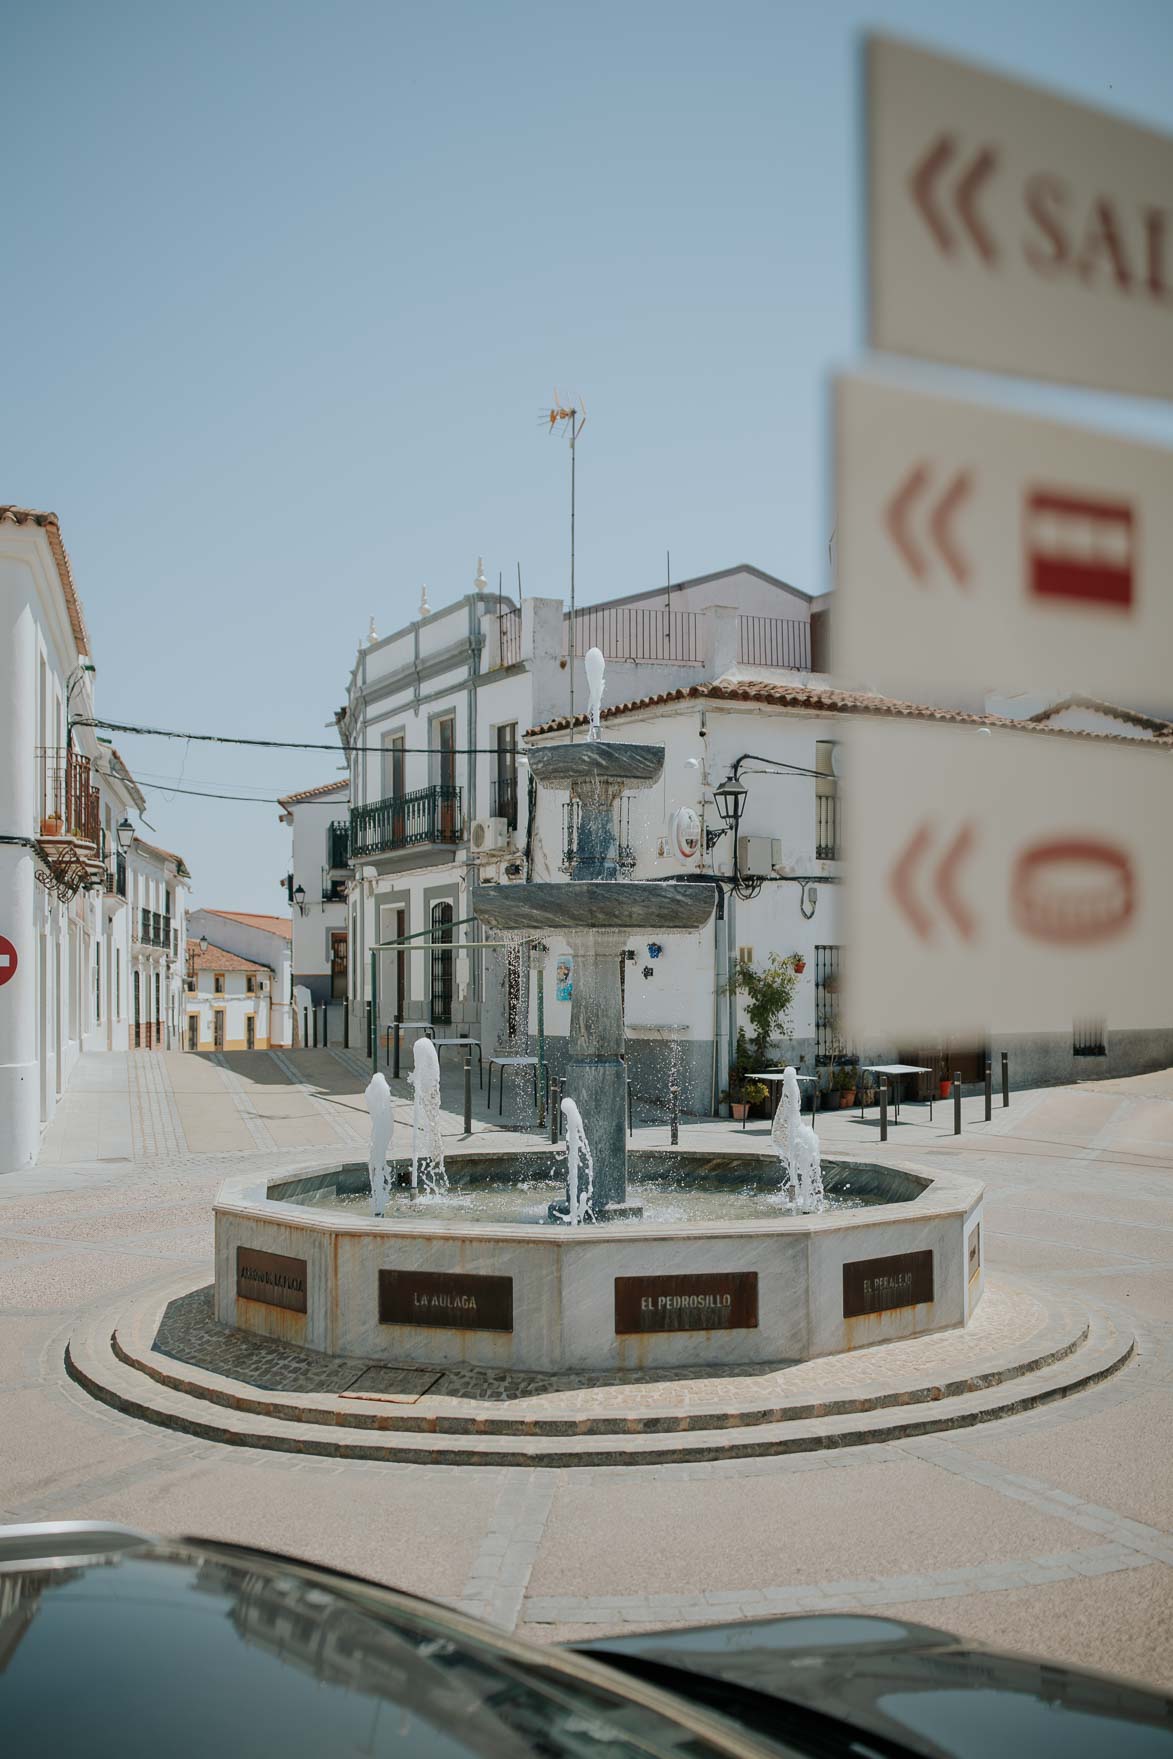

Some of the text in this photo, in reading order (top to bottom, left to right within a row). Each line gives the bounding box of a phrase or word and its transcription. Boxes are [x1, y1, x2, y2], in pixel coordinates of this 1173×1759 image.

[414, 1292, 477, 1309] LA AULAGA
[641, 1294, 731, 1310] EL PEDROSILLO
